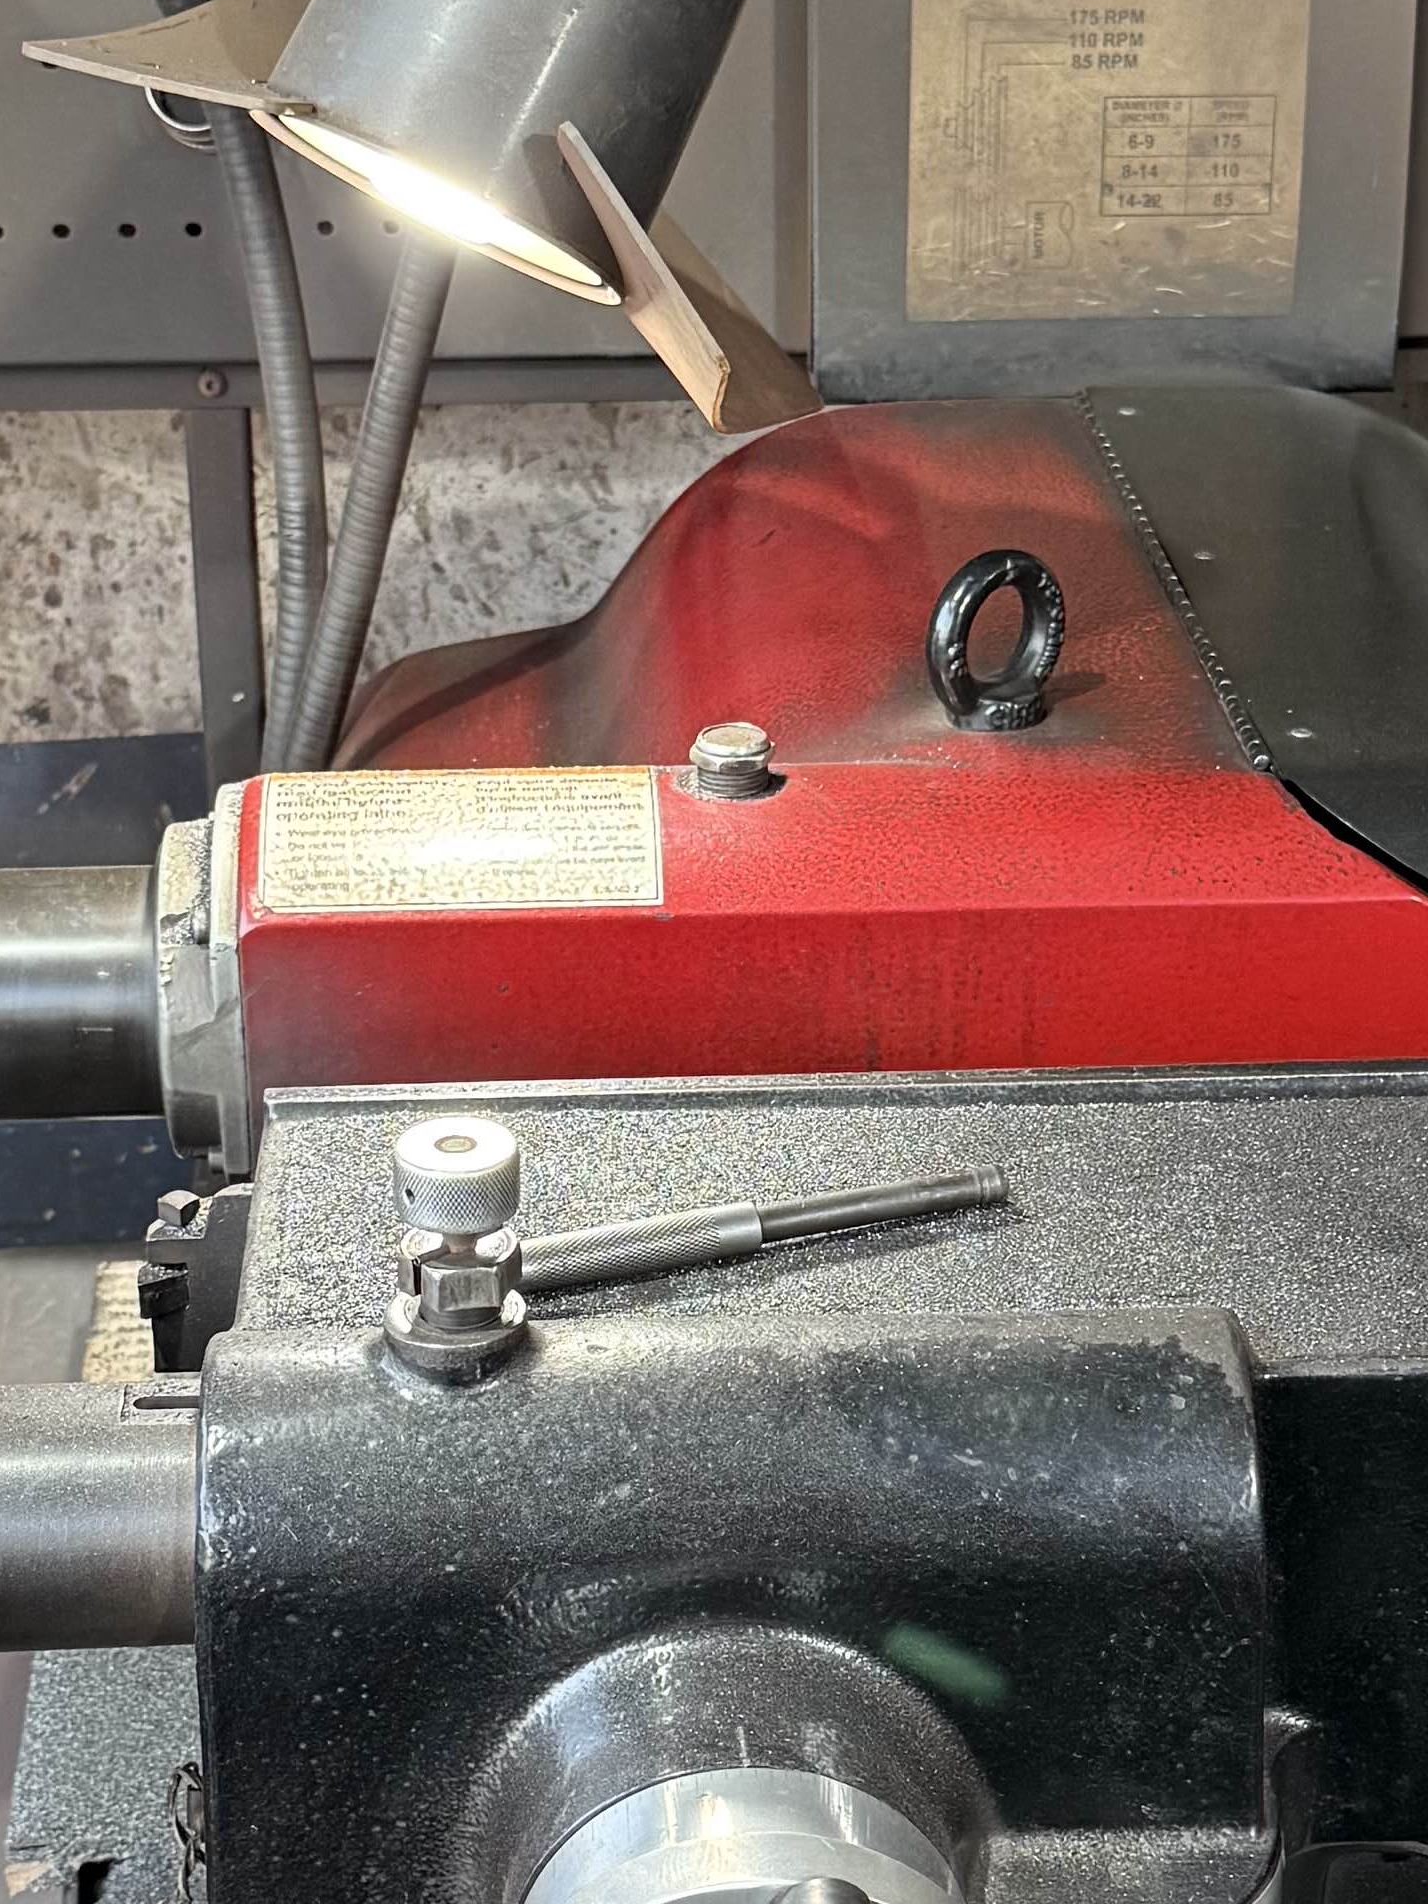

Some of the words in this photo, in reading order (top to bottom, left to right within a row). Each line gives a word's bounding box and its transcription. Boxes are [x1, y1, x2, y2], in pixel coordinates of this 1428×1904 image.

[1069, 9, 1099, 25] 175
[1104, 8, 1145, 25] RPM
[1069, 32, 1098, 48] 110
[1102, 31, 1144, 48] RPM
[1071, 53, 1093, 69] 85
[1097, 53, 1138, 69] RPM
[1127, 133, 1155, 150] 6-9
[1212, 132, 1241, 149] 175
[1211, 162, 1240, 178] 110
[1034, 210, 1046, 260] MOTOR
